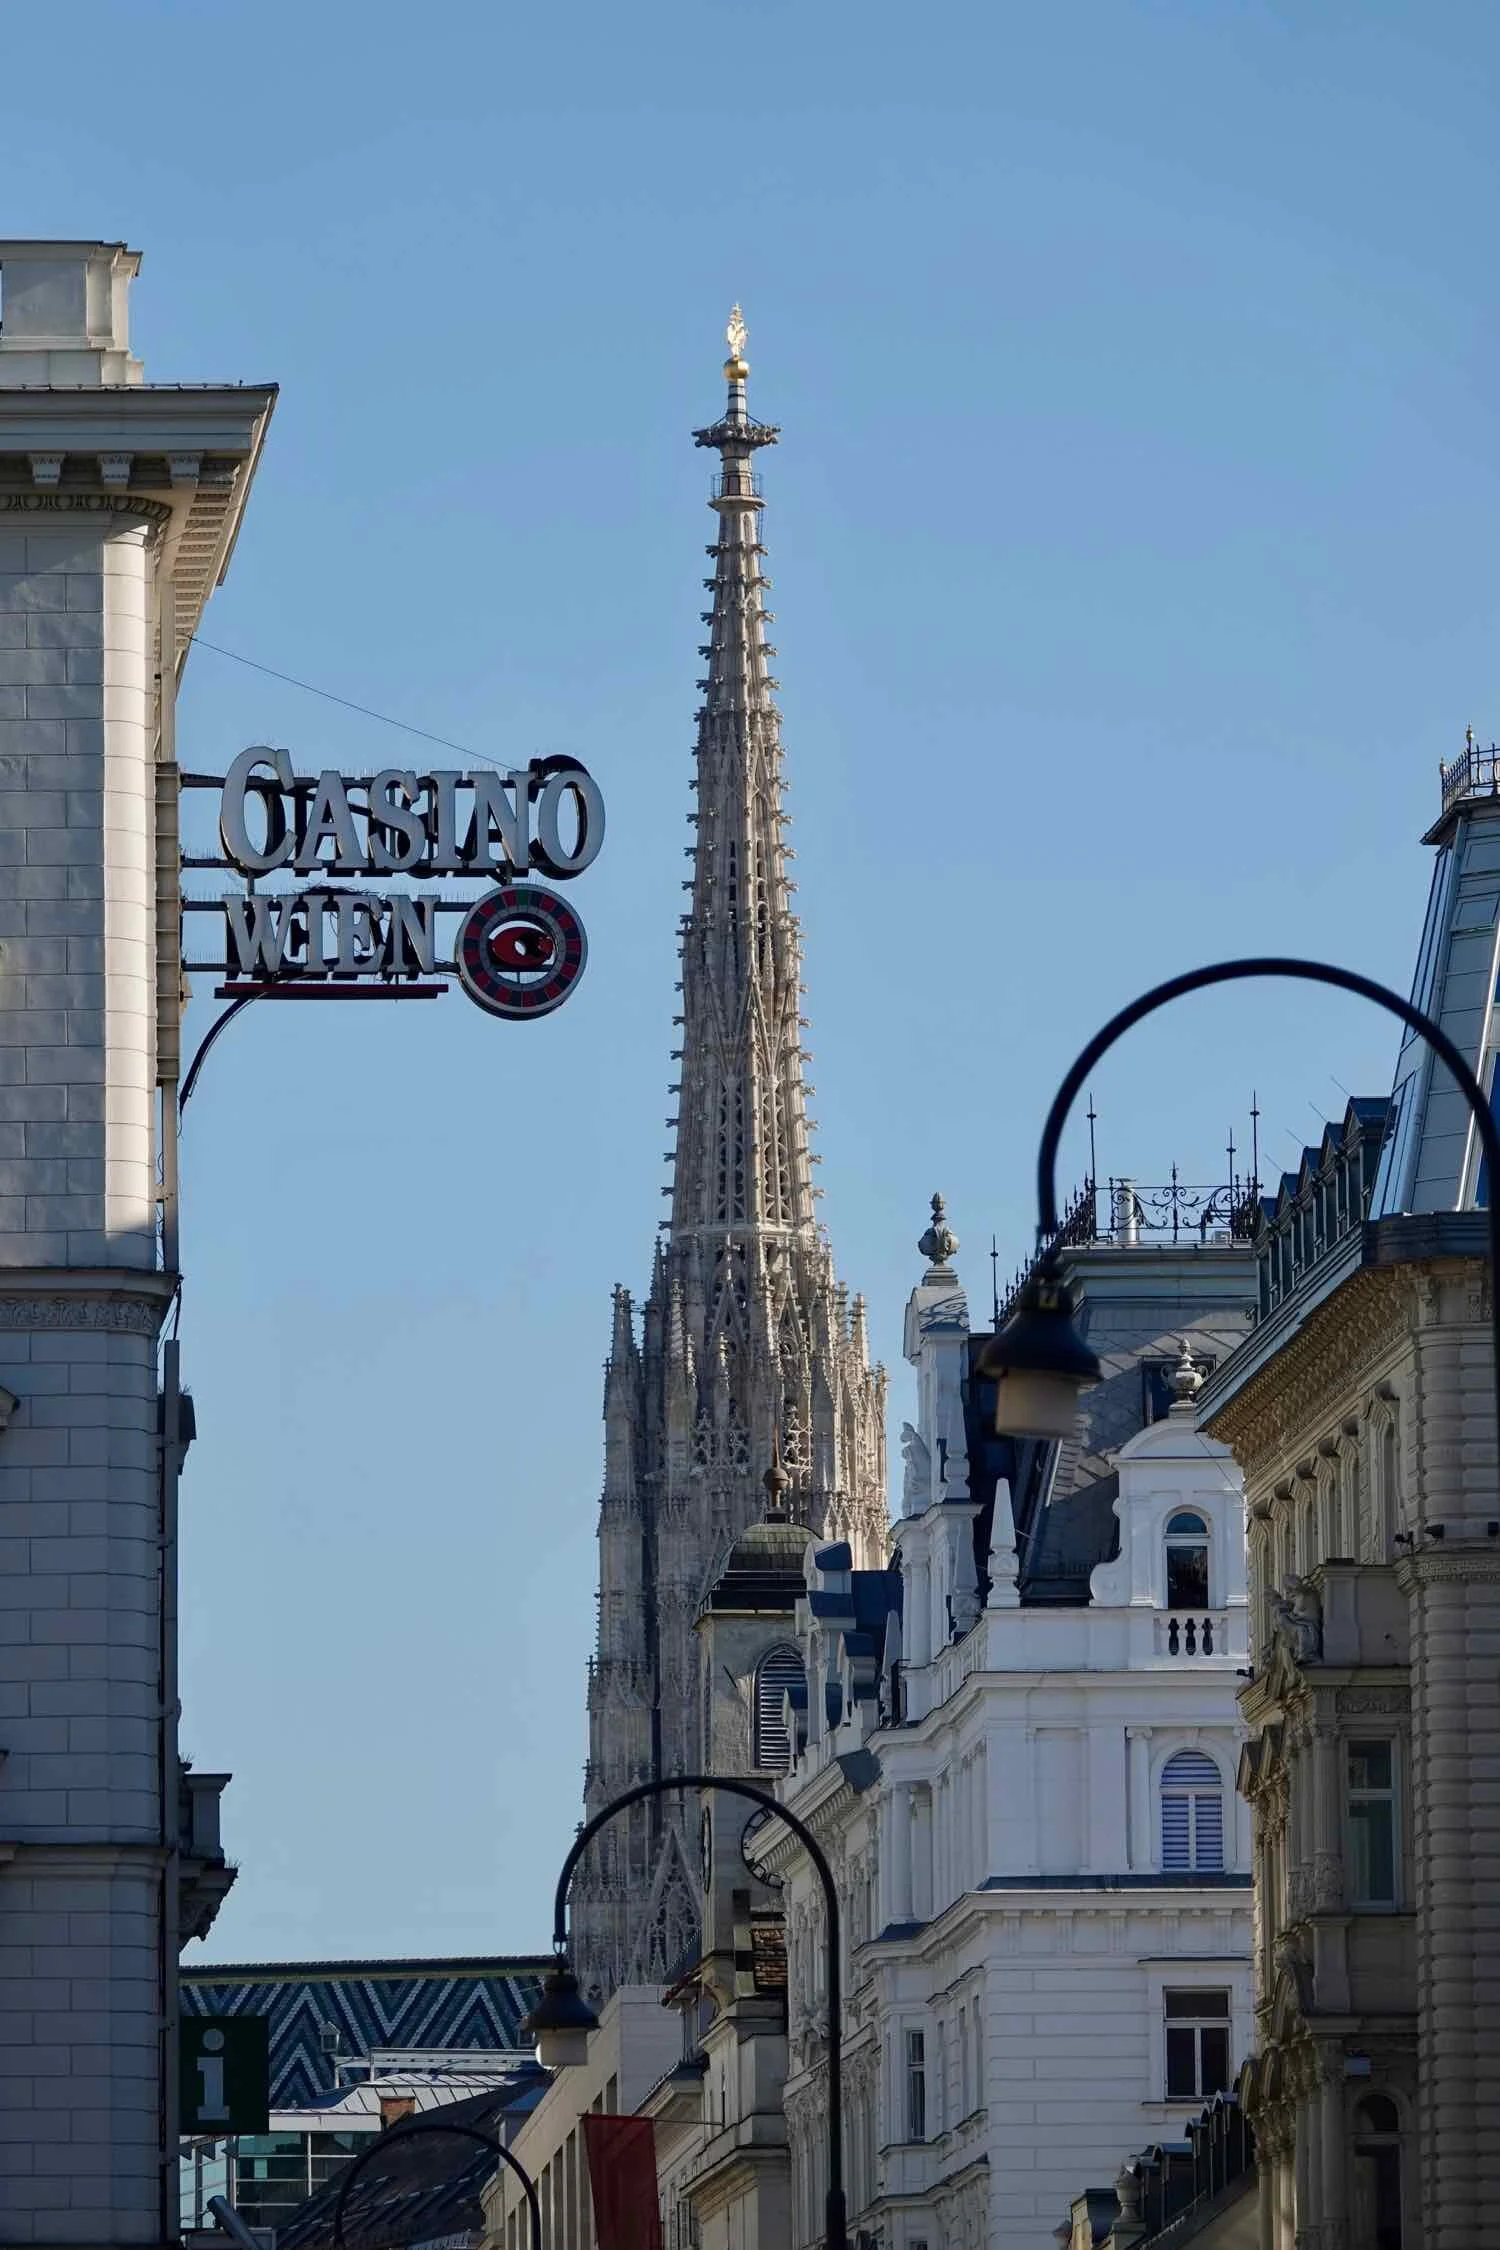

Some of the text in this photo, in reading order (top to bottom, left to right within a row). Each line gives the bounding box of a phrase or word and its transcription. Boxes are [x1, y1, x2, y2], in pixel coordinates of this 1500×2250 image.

[220, 746, 605, 871] CASINO
[222, 894, 441, 974] WIEN
[197, 2028, 231, 2121] i
